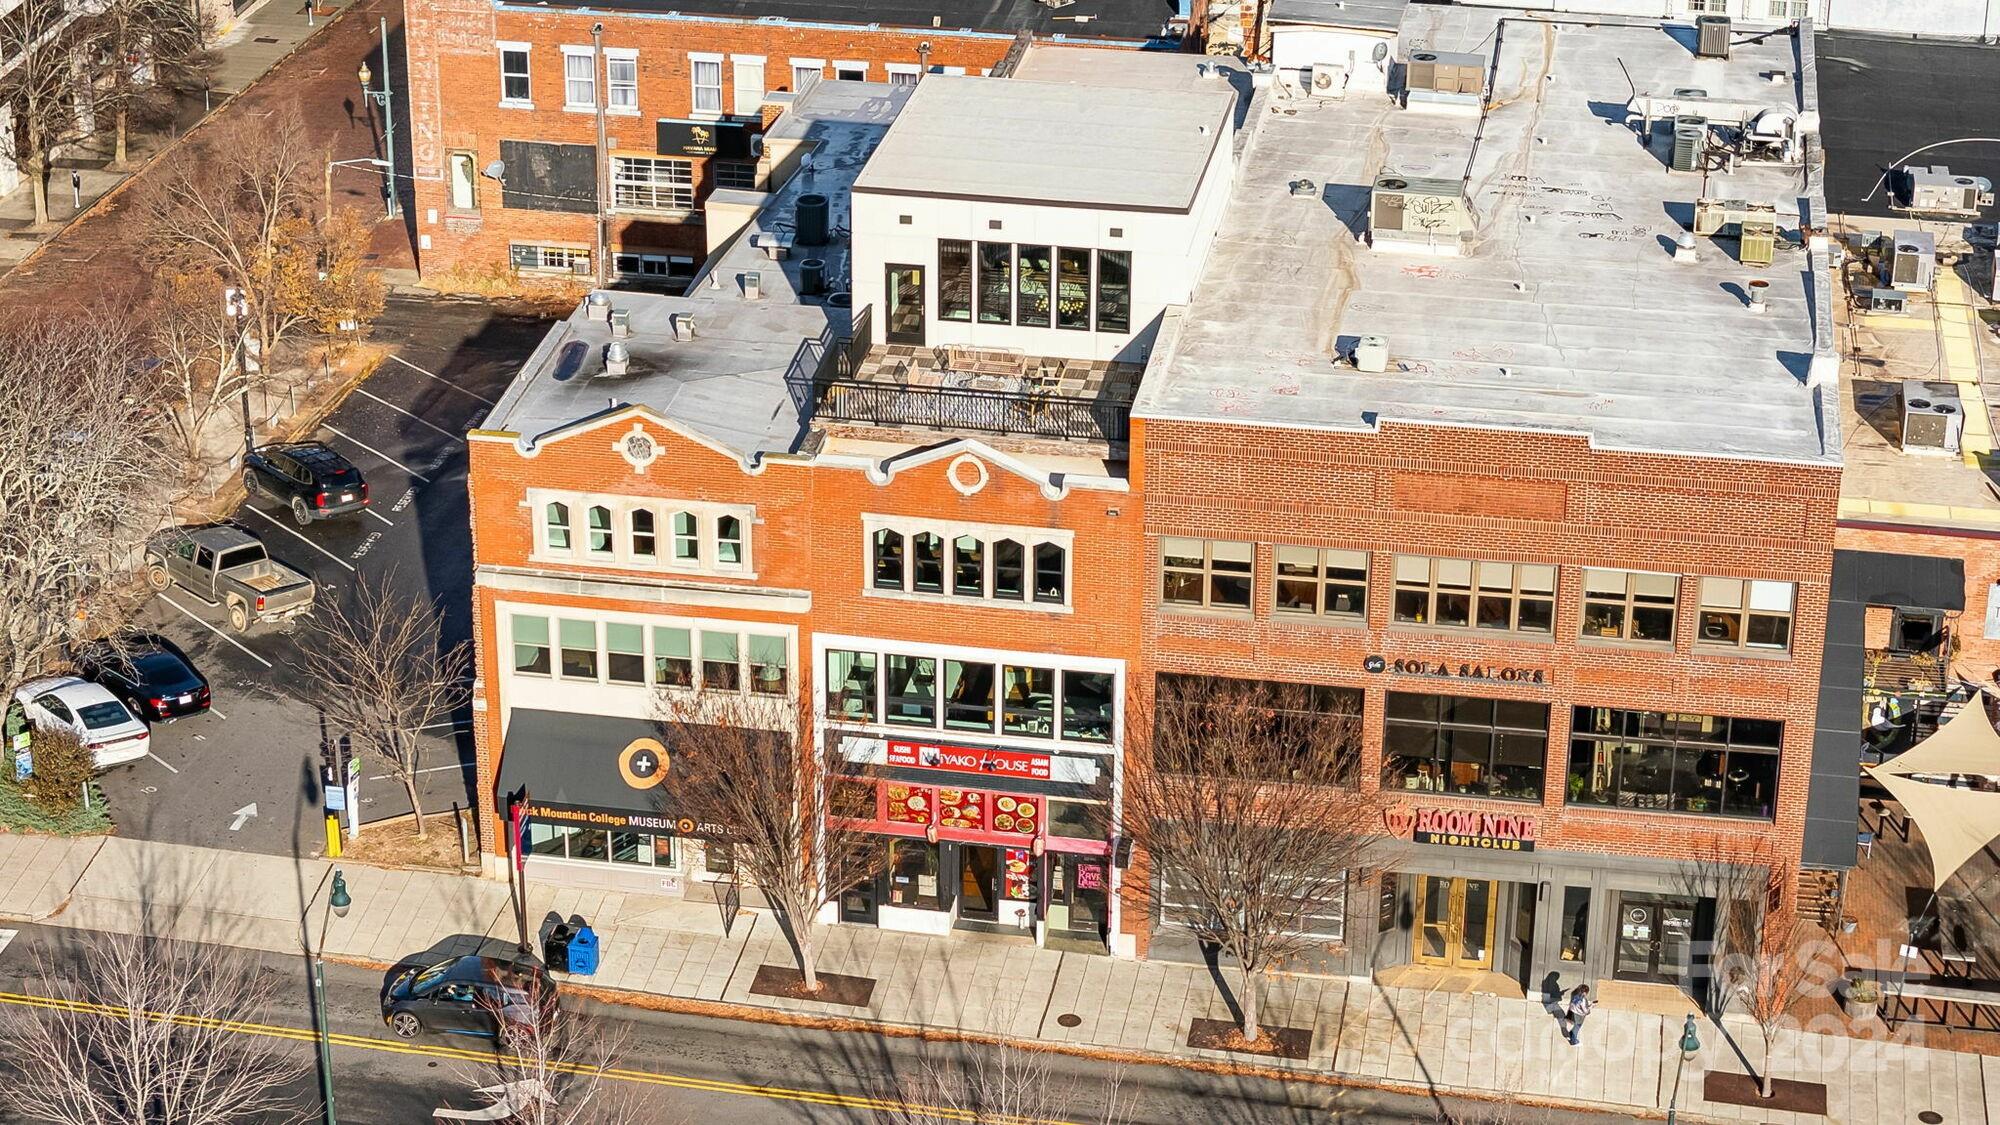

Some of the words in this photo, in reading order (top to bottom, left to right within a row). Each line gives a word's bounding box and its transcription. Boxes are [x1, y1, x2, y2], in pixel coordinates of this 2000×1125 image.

[1393, 658, 1450, 678] SOLA
[1458, 663, 1545, 684] SALONS
[893, 745, 912, 754] SUSHI
[888, 754, 916, 764] SEAFOOD
[1030, 757, 1049, 767] ASIAN
[1030, 767, 1049, 777] FOOD
[540, 807, 587, 821] Mountain
[589, 812, 626, 826] College
[628, 816, 677, 830] MUSEUM
[696, 822, 724, 835] ARTS
[1416, 808, 1477, 837] ROOM
[1482, 811, 1536, 841] NINE
[1430, 833, 1521, 850] NIGHTCLUB
